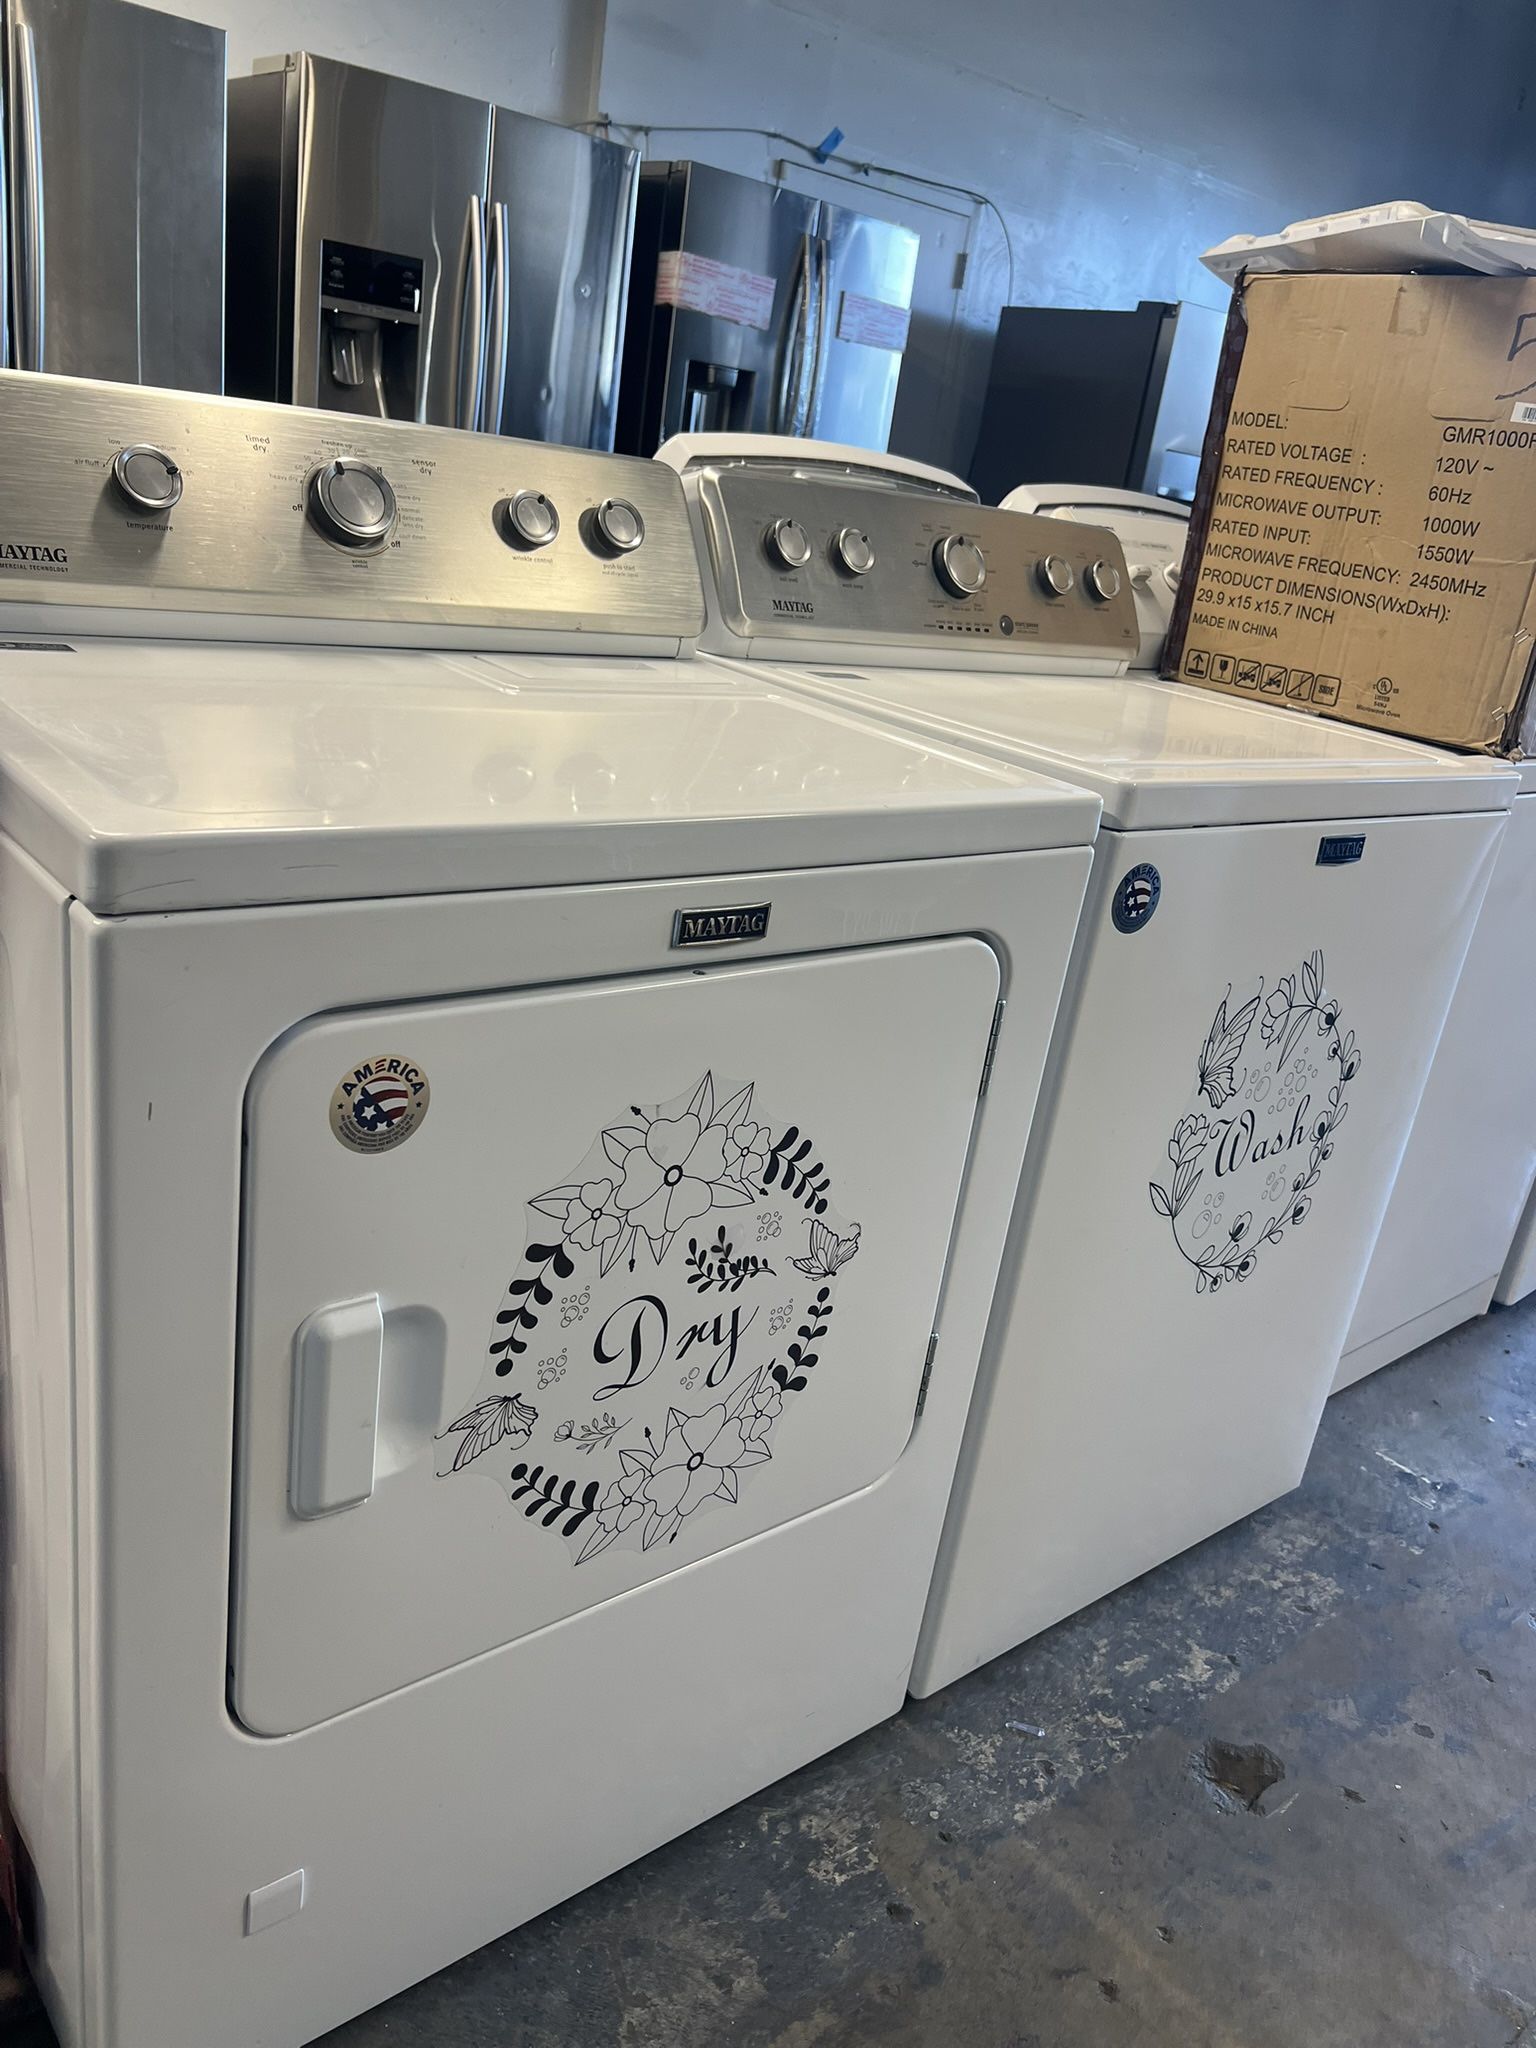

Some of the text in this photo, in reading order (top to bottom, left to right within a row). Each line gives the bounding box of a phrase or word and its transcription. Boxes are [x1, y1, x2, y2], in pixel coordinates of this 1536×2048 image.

[1231, 411, 1289, 430] MODEL:
[245, 434, 270, 444] timed
[252, 443, 267, 453] dry
[411, 459, 437, 468] sensor
[1226, 438, 1276, 457] RATED
[1280, 443, 1353, 464] VOLTAGE
[1436, 456, 1479, 475] 120V
[419, 467, 432, 477] dry
[1221, 464, 1271, 483] RATED
[1274, 470, 1376, 494] FREQUENCY
[1428, 485, 1472, 505] 60Hz
[291, 503, 304, 512] off
[1216, 492, 1481, 537] MICROWAVE OUTPUT: 1000W
[126, 521, 174, 532] temperature
[0, 544, 67, 563] AYTAG
[1211, 518, 1474, 565] RATED INPUT: 1550W
[1205, 542, 1487, 598] MICROWAVE FREQUENCY: 2450MHz
[772, 599, 814, 613] MAYTAG
[1197, 588, 1225, 605] 29.9
[1254, 600, 1293, 617] x15.7
[1296, 605, 1335, 625] INCH
[1201, 567, 1451, 624] PRODUCT DIMENSIONS(WxDxH):
[1192, 612, 1279, 639] MADE IN CHINA
[1323, 841, 1363, 857] MAYTAG
[1125, 865, 1159, 896] AMERICA
[682, 913, 765, 939] MAYTAG
[342, 1058, 425, 1097] AMERICA
[1209, 1094, 1312, 1177] Wash
[593, 1294, 760, 1401] Dry
